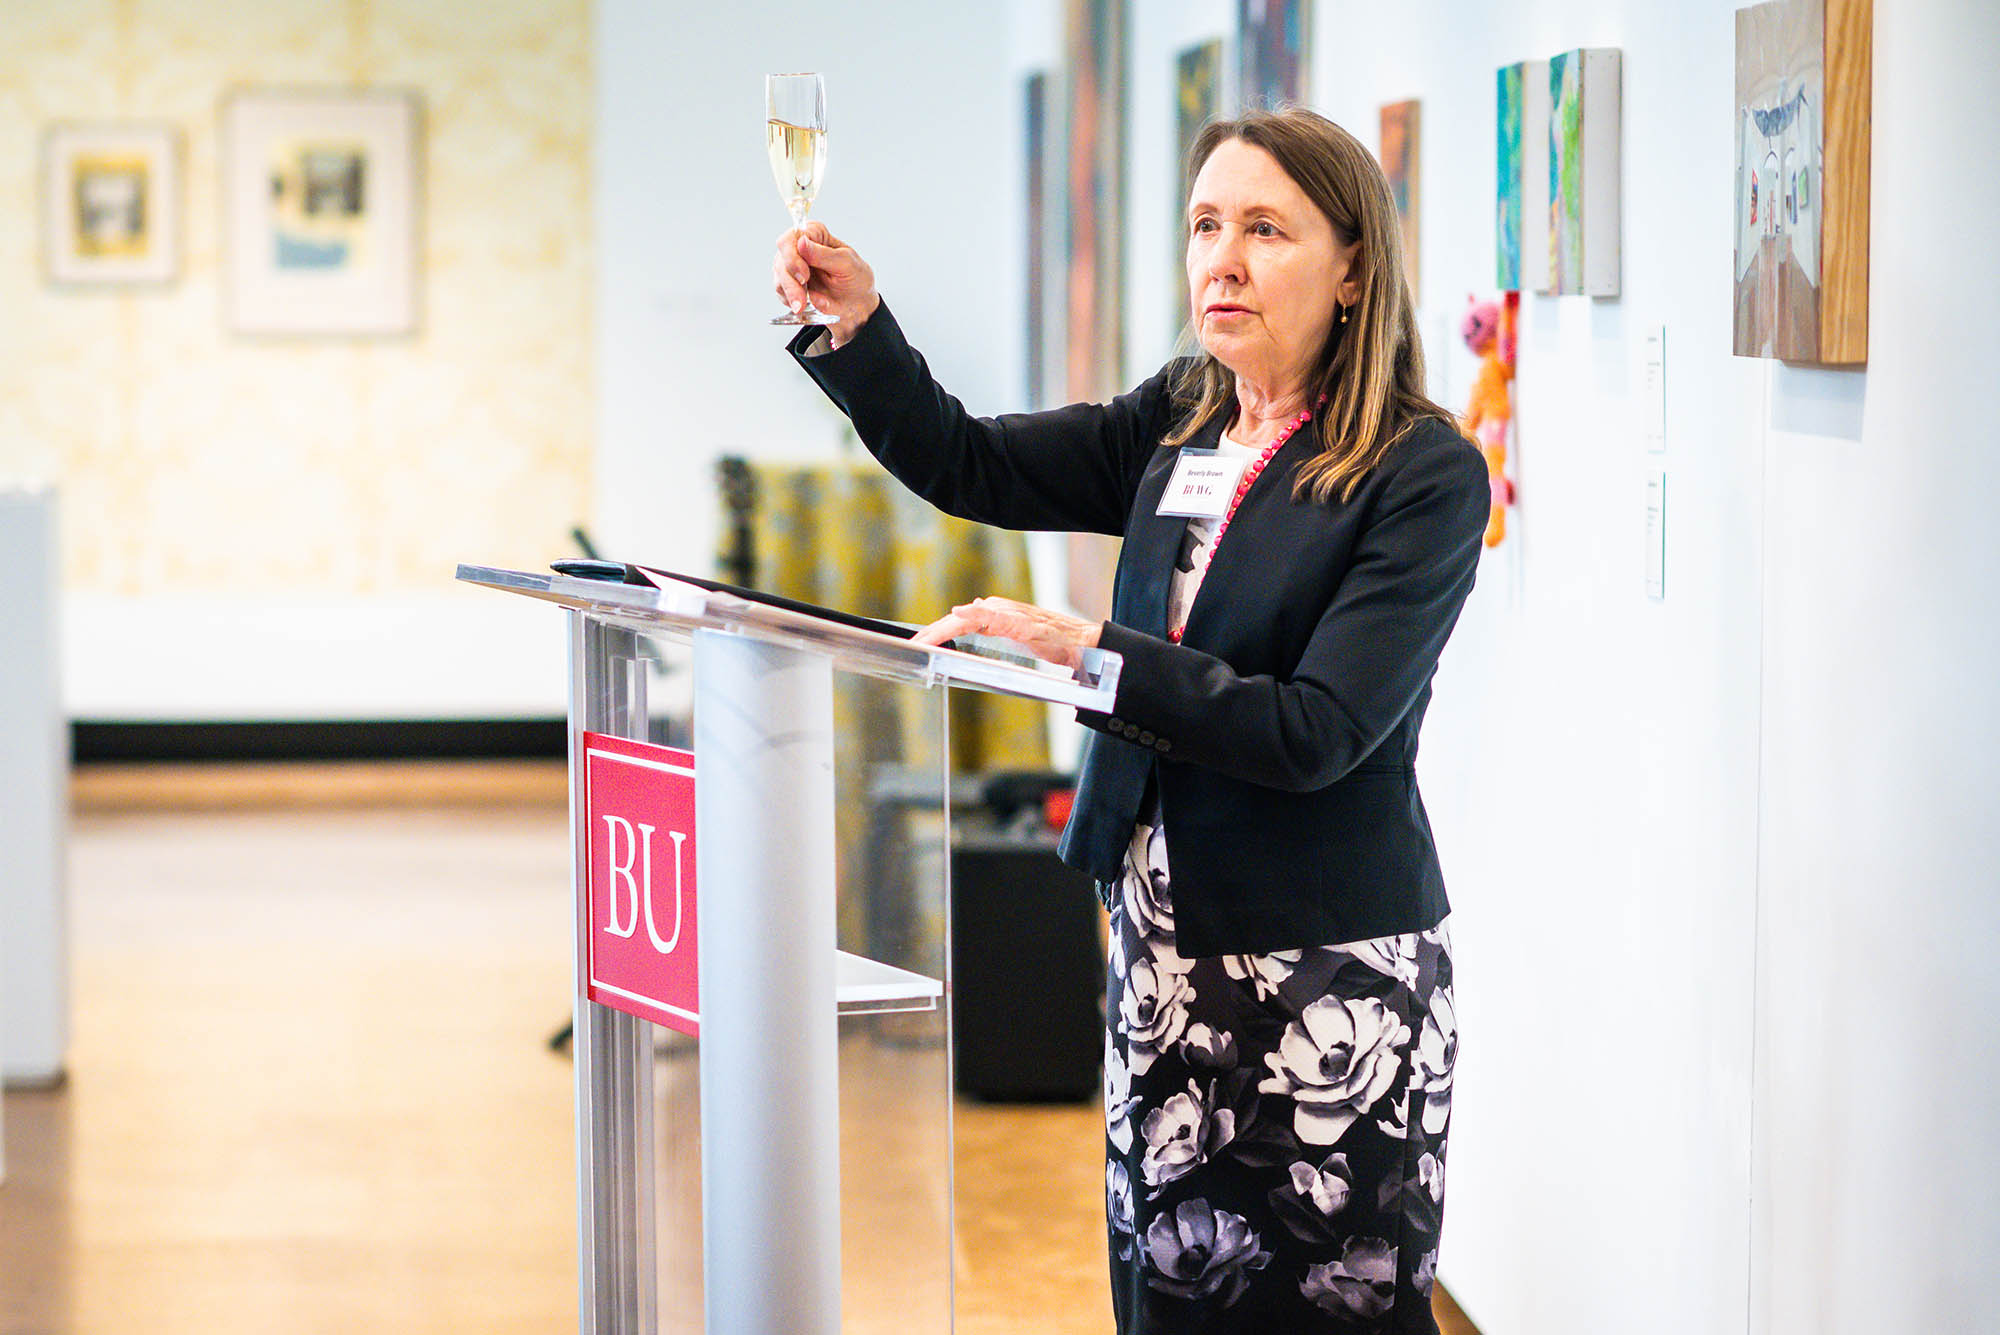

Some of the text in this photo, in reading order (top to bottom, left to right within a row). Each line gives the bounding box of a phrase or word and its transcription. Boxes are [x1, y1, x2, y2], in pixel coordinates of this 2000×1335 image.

[1187, 469, 1224, 478] Beverly Brown
[602, 815, 687, 955] BU
